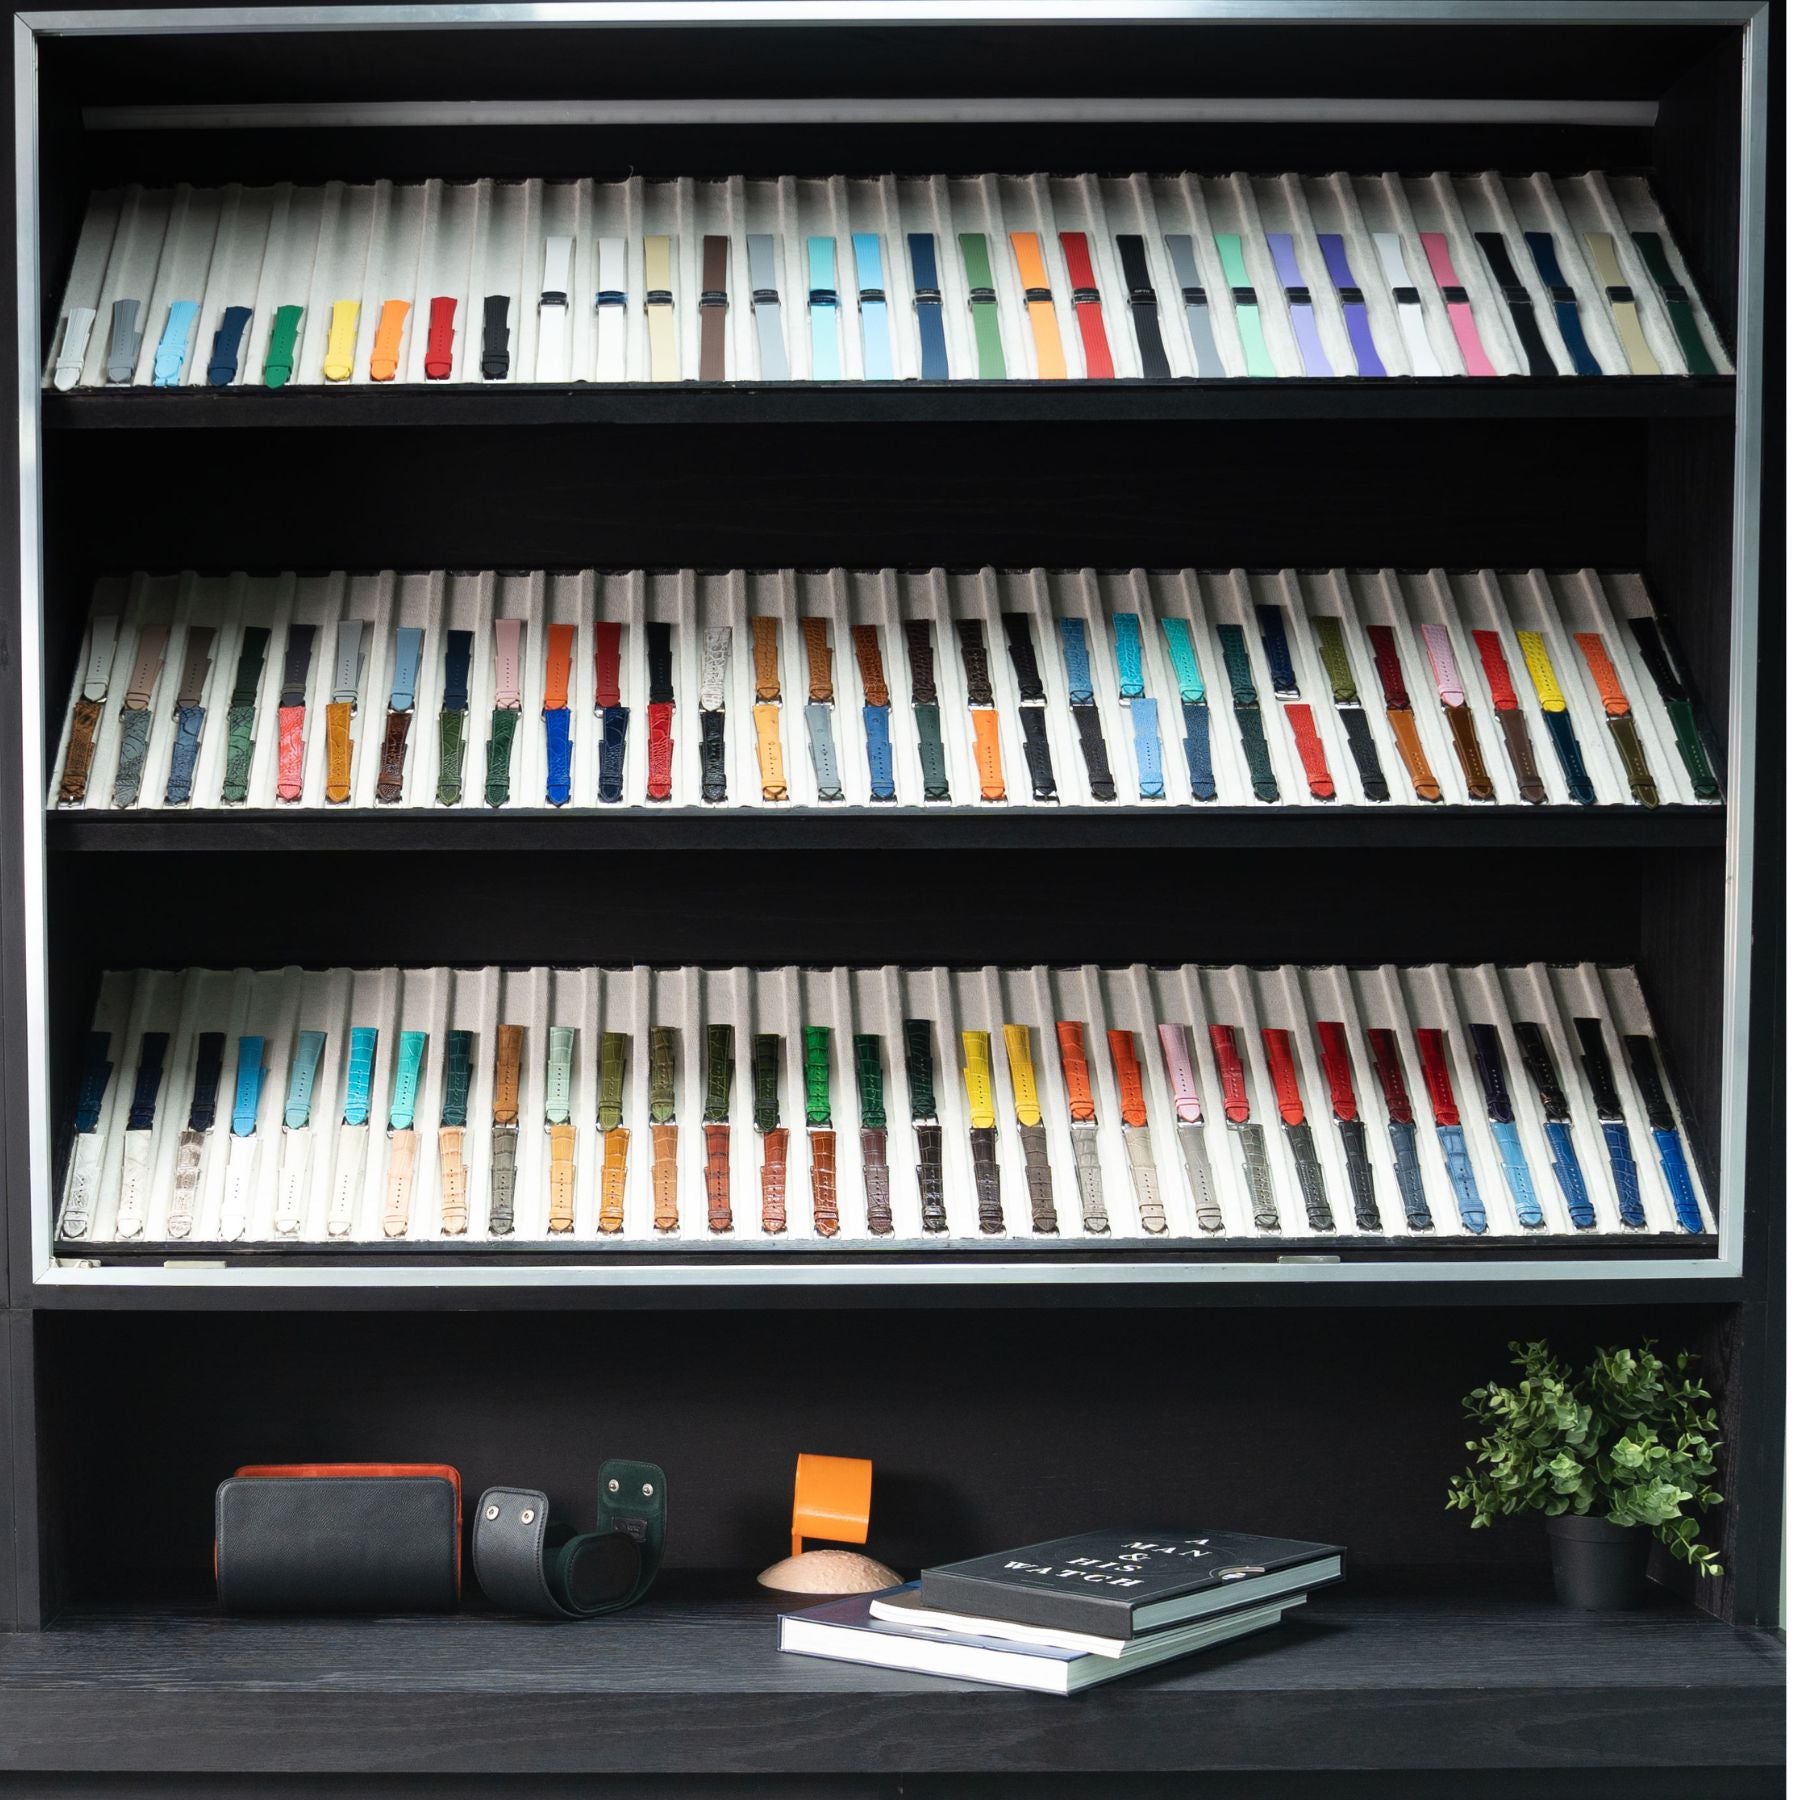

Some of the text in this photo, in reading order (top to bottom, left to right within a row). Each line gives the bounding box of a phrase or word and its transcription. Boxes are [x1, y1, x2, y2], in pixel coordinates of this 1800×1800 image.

[1118, 1552, 1151, 1562] &
[1120, 1541, 1212, 1558] MAN
[1065, 1557, 1143, 1572] HIS
[1003, 1560, 1145, 1587] WATCH
